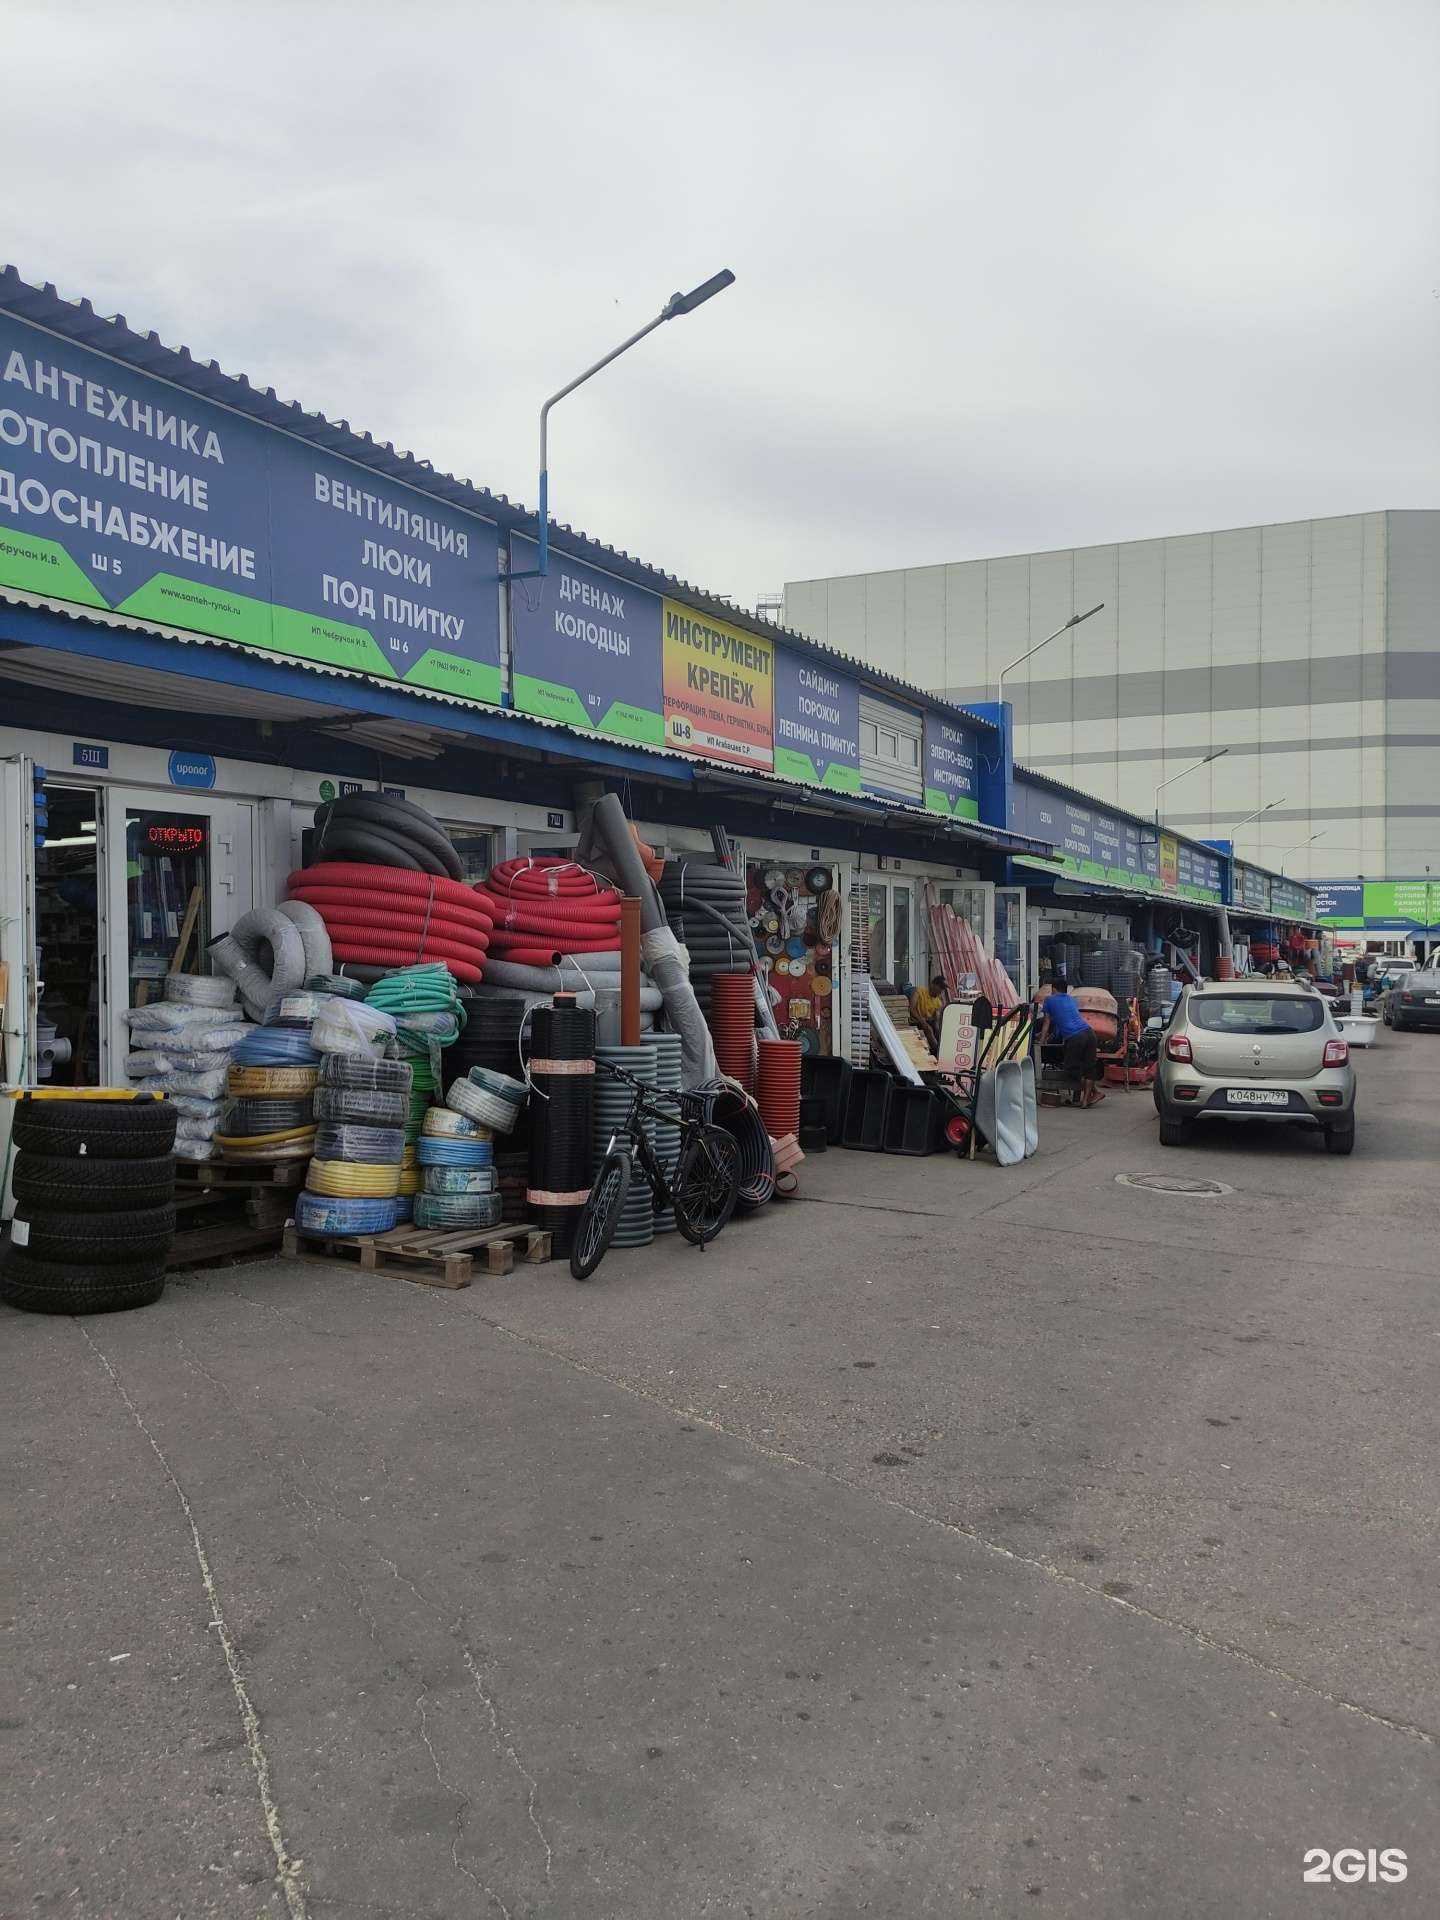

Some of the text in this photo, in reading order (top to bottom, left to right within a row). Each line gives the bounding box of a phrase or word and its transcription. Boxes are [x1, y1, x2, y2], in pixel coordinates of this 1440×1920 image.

[3, 350, 225, 465] АНТЕХНИКА
[0, 408, 209, 512] ОТОПЛЕНИЕ
[314, 472, 469, 559] ВЕНТИЛЯЦИЯ
[91, 552, 122, 576] Ш 5
[361, 539, 432, 588] ЛЮКИ
[160, 585, 241, 616] www.santeh-rynok.ru
[322, 573, 465, 641] ПОД ПЛИТКУ
[559, 574, 625, 619] ДРЕНАЖ
[389, 636, 409, 654] Ш 6
[554, 610, 631, 657] КОЛОДЦЫ
[666, 611, 770, 675] ИНСТРУМЕНТ
[687, 661, 755, 708] КРЕПЁЖ
[798, 668, 839, 698] САЙДИНГ
[798, 696, 840, 726] ПОРОЖКИ
[672, 721, 691, 739] Ш-8
[778, 718, 857, 758] ЛЕПНИНА ПЛИНТУС
[941, 725, 963, 746] ПРОКАТ
[176, 763, 209, 777] uponor
[933, 767, 972, 792] ИНСТРУМЕНТА
[149, 827, 202, 842] ОТКРЫТО
